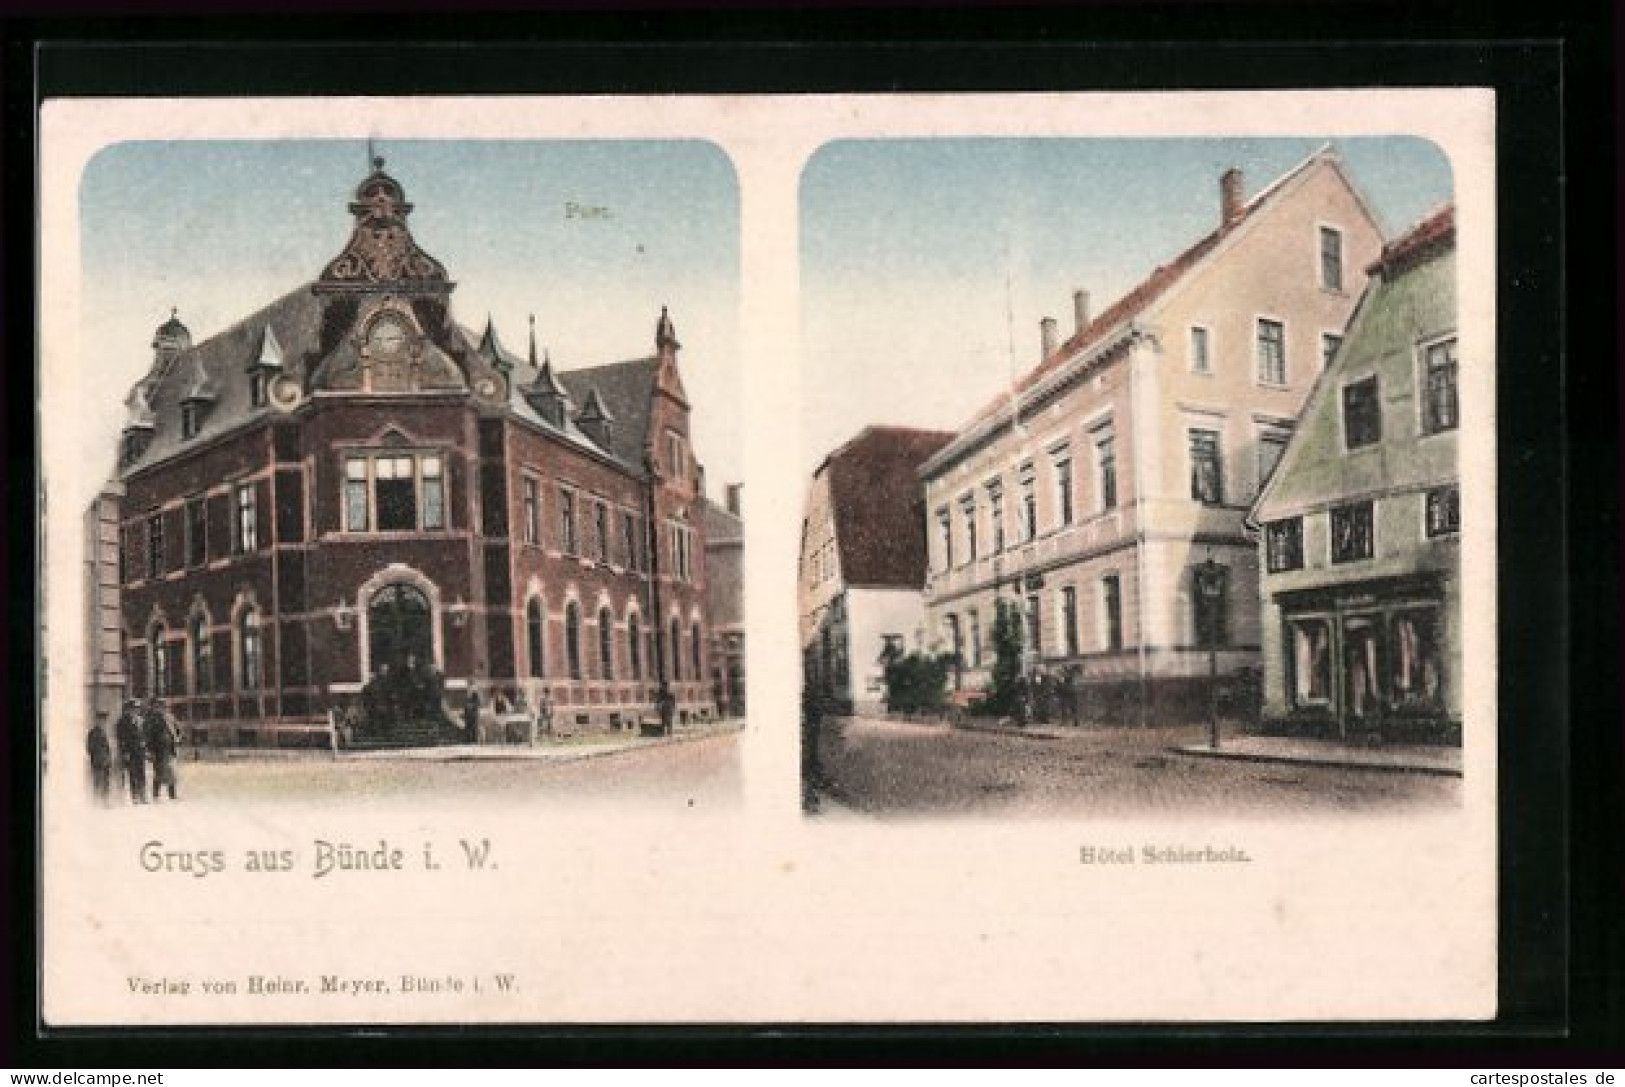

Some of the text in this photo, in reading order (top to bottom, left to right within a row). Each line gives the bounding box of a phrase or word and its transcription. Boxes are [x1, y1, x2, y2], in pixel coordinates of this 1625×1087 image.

[140, 838, 499, 879] Gruss aus Bünde i. W.
[127, 975, 191, 996] Verlag
[201, 980, 237, 995] von
[248, 975, 310, 997] Heinr.
[495, 974, 520, 993] W.
